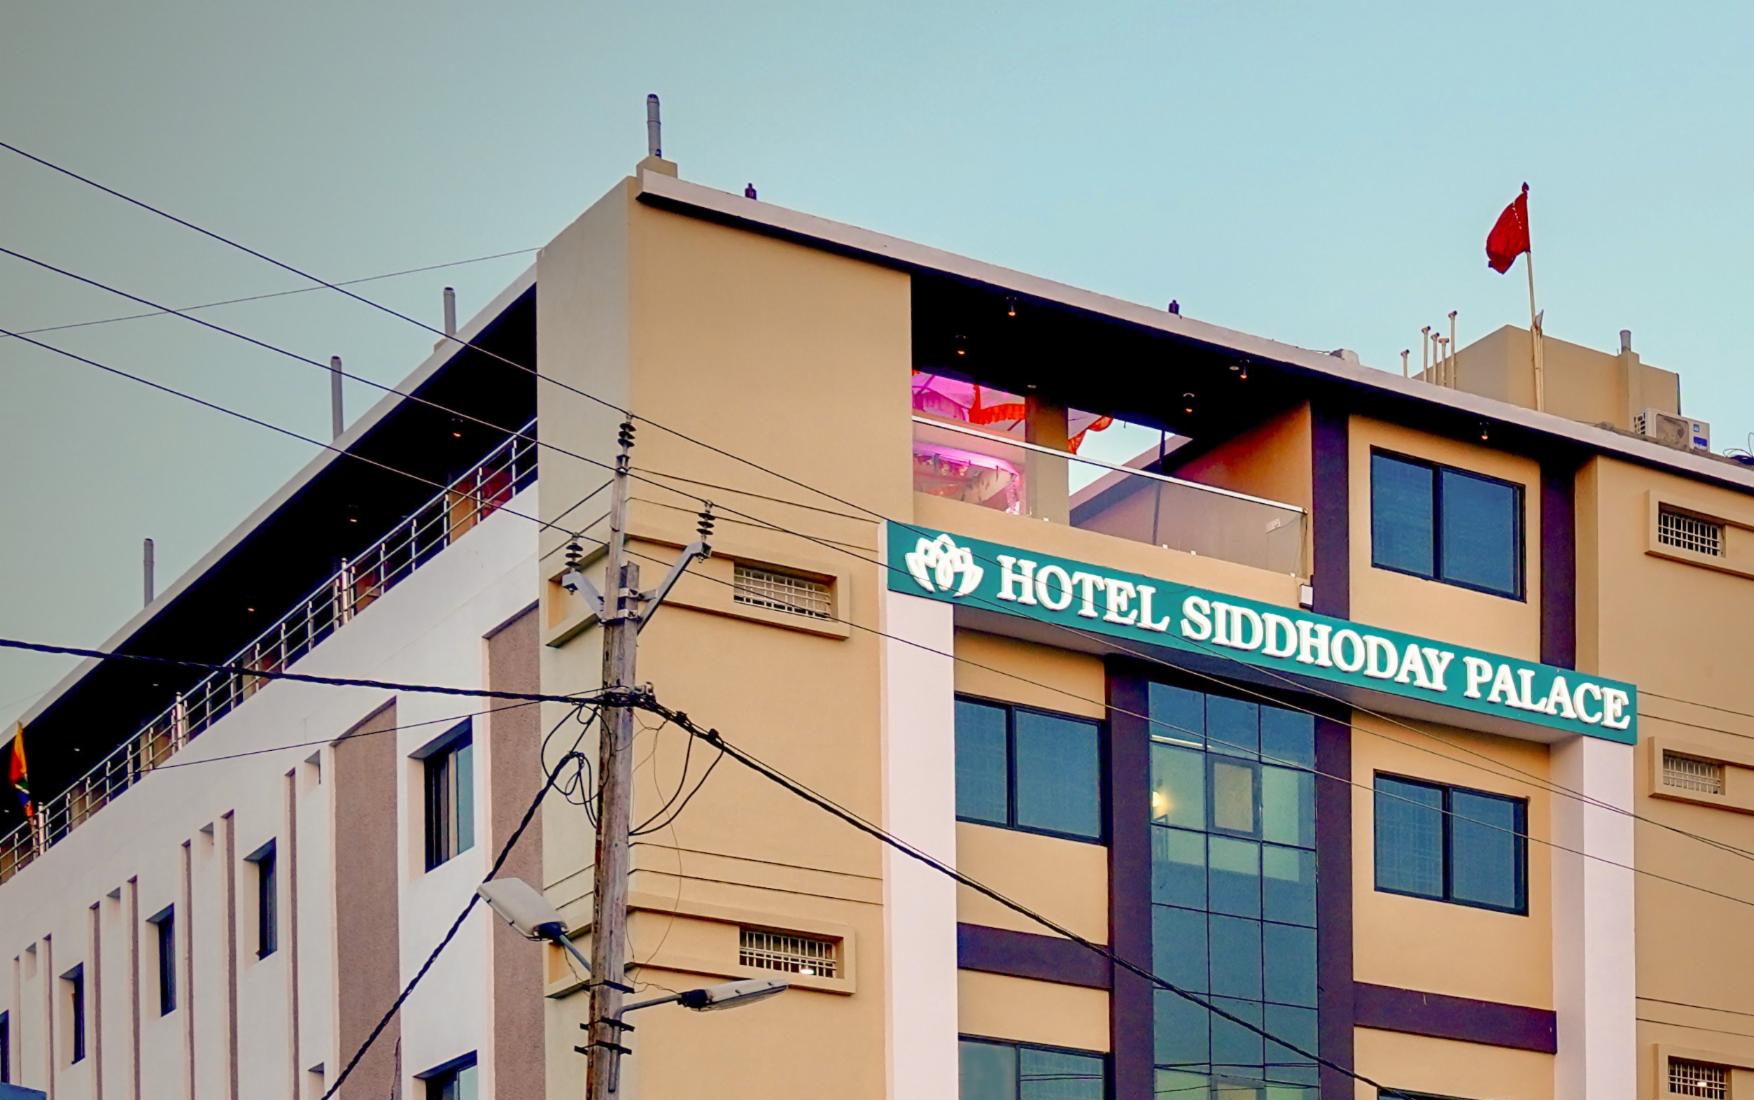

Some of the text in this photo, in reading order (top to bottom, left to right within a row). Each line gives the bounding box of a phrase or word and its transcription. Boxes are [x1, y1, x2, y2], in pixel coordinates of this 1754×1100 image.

[996, 554, 1632, 731] HOTEL SIDDHODAY PALACE
